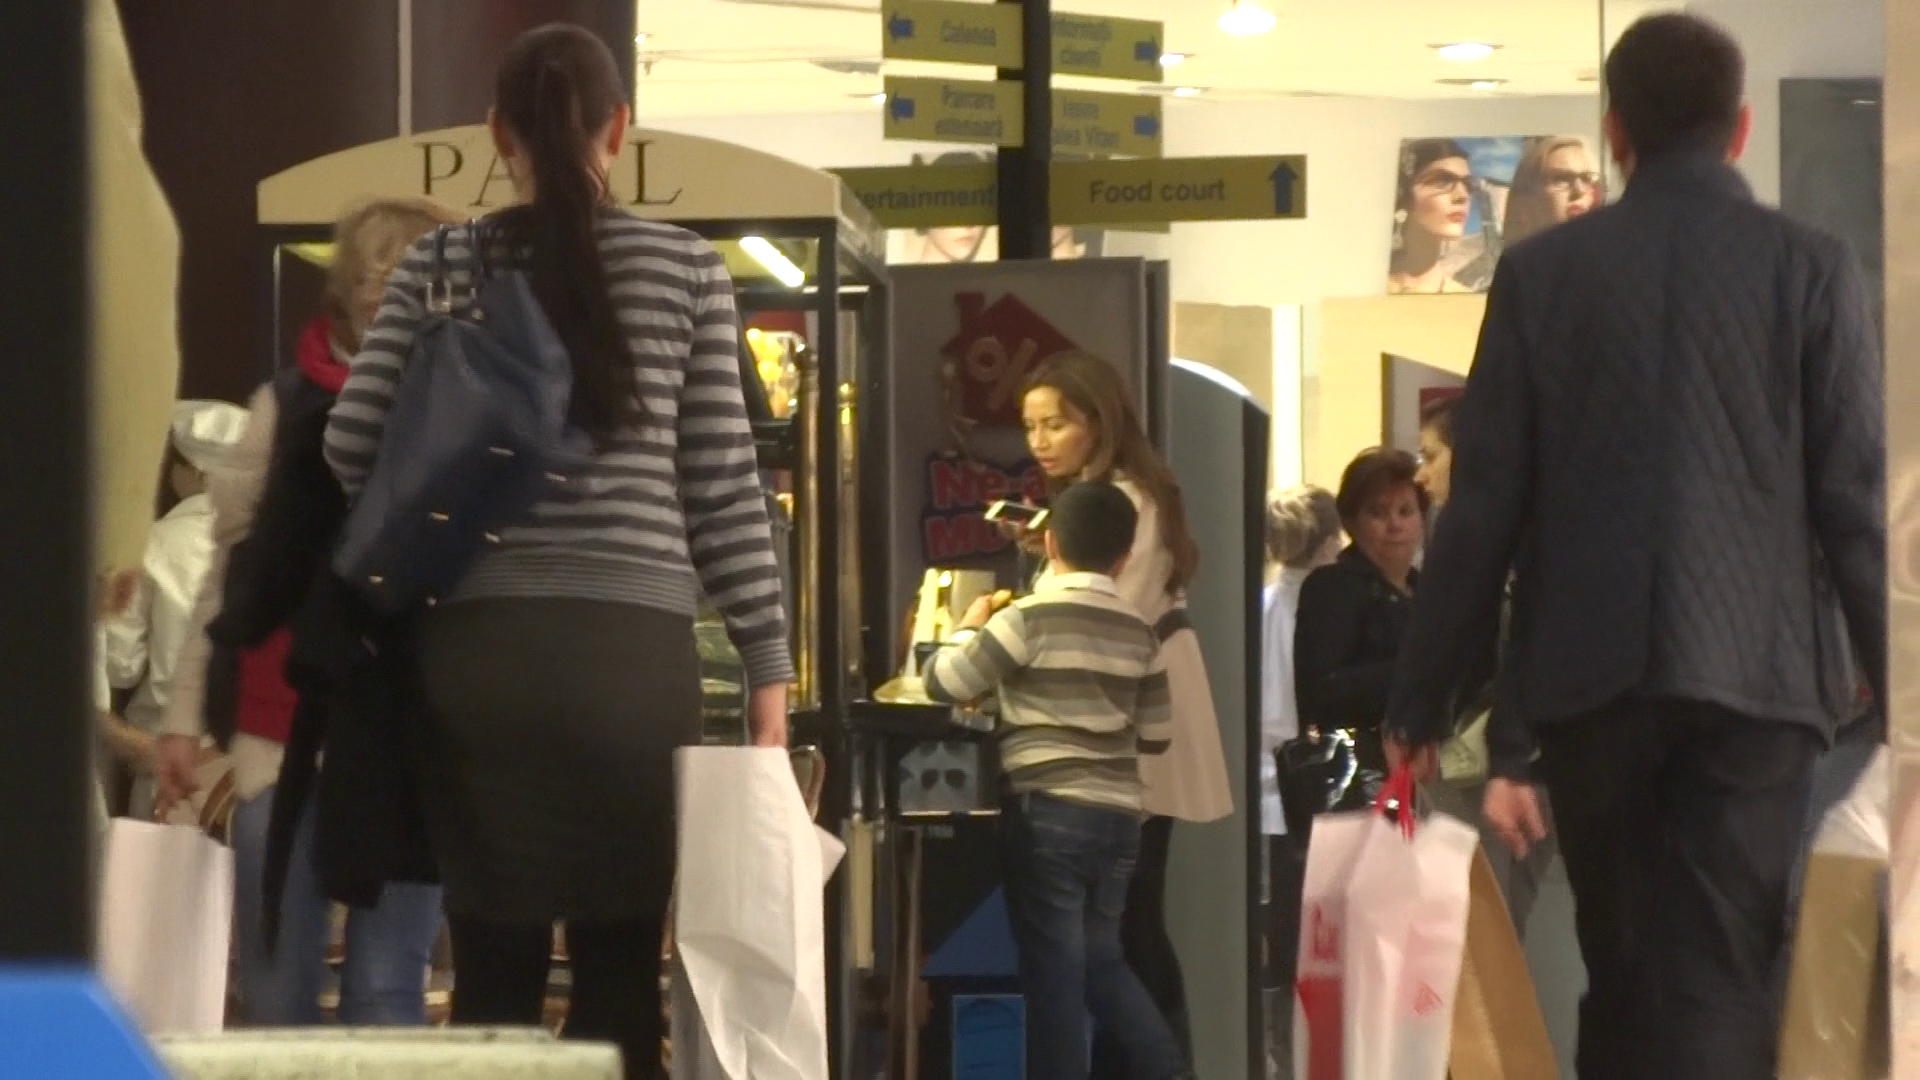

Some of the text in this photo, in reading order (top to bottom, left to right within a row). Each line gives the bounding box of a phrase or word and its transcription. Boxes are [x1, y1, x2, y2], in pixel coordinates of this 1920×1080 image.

[413, 140, 683, 206] PAL
[1089, 177, 1226, 203] Food court
